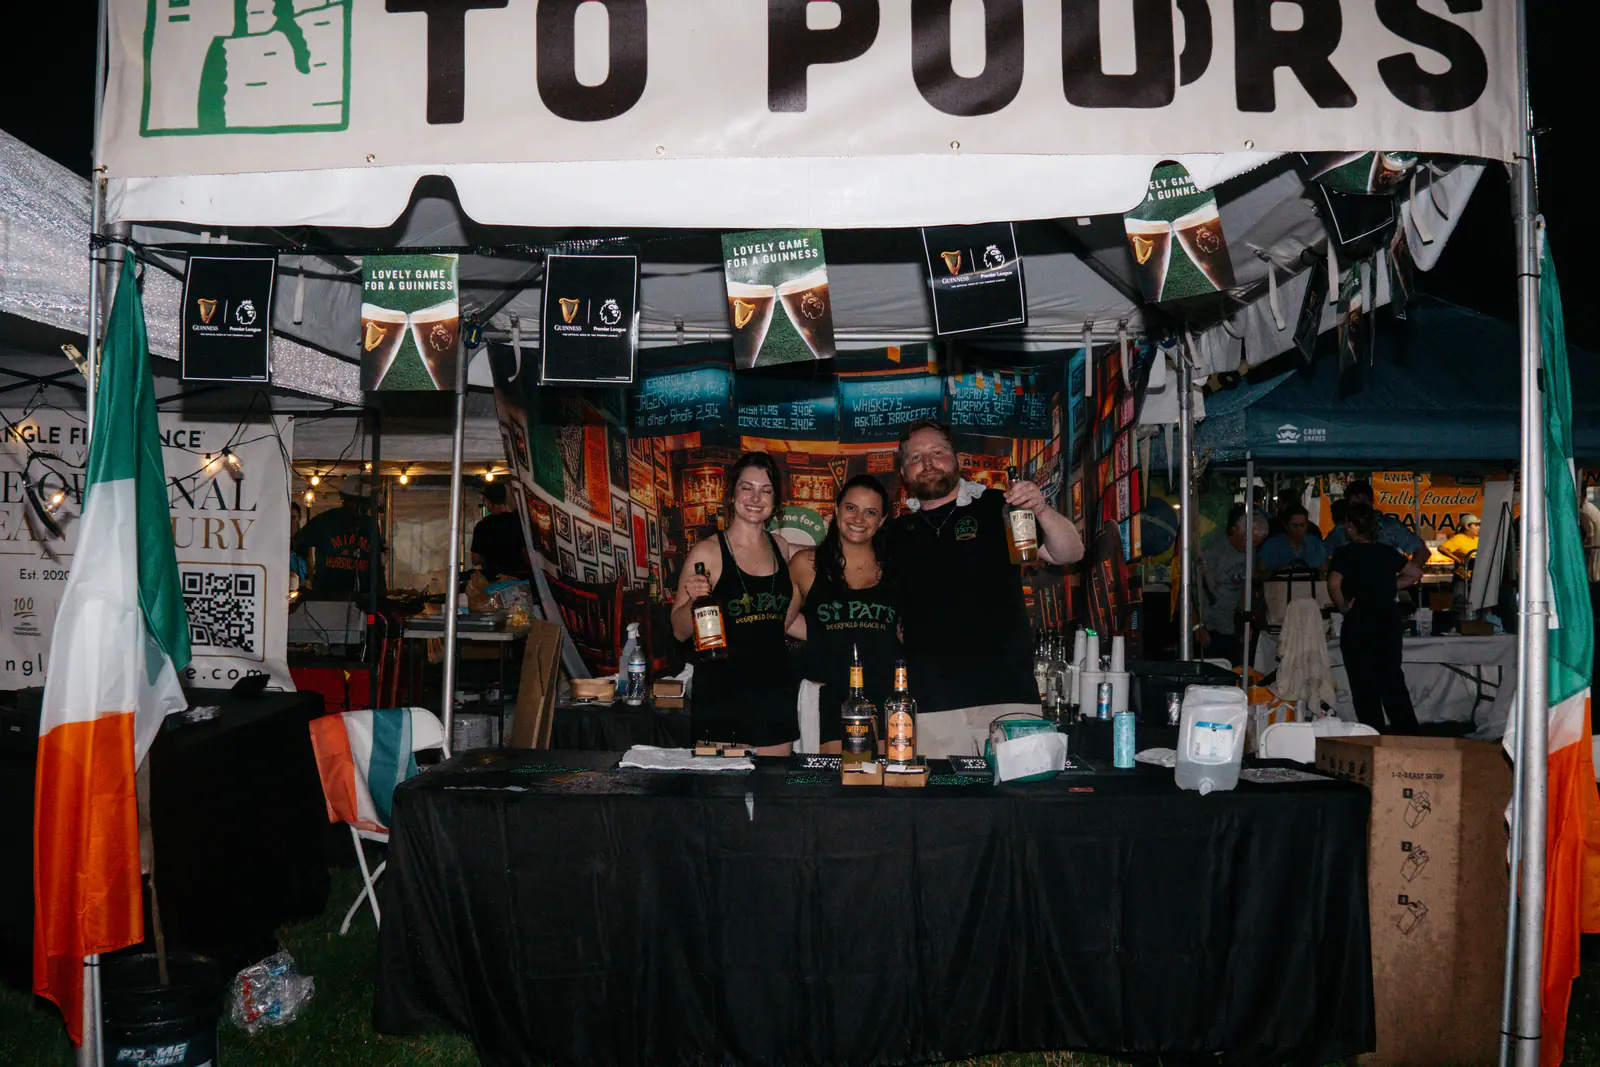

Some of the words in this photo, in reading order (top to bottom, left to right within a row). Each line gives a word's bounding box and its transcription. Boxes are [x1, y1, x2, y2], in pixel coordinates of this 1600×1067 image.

[385, 0, 649, 124] TO
[1150, 178, 1168, 190] ELY
[1171, 175, 1194, 187] GAM
[1148, 192, 1154, 202] A
[1157, 186, 1200, 201] GUINNE
[733, 243, 775, 257] LOVELY
[779, 238, 809, 251] GAME
[727, 257, 749, 269] FOR
[752, 255, 760, 266] A
[763, 248, 819, 264] GUINNESS
[371, 269, 411, 280] LOVELY
[415, 269, 446, 280] GAME
[942, 276, 970, 285] GUINNESS
[365, 281, 384, 291] FOR
[388, 281, 395, 291] A
[399, 280, 454, 291] GUINNESS
[192, 324, 220, 332] GUINNESS
[553, 324, 583, 332] GUINNESS
[670, 407, 693, 424] Shots
[738, 416, 760, 428] CORK
[854, 415, 870, 428] ASK
[870, 413, 886, 427] THE
[887, 407, 939, 426] BARKEEPER
[1421, 489, 1481, 505] Loaded
[20, 568, 39, 581] Est.
[13, 597, 34, 612] 100
[1408, 771, 1425, 780] EASY
[1425, 772, 1445, 780] SETUP
